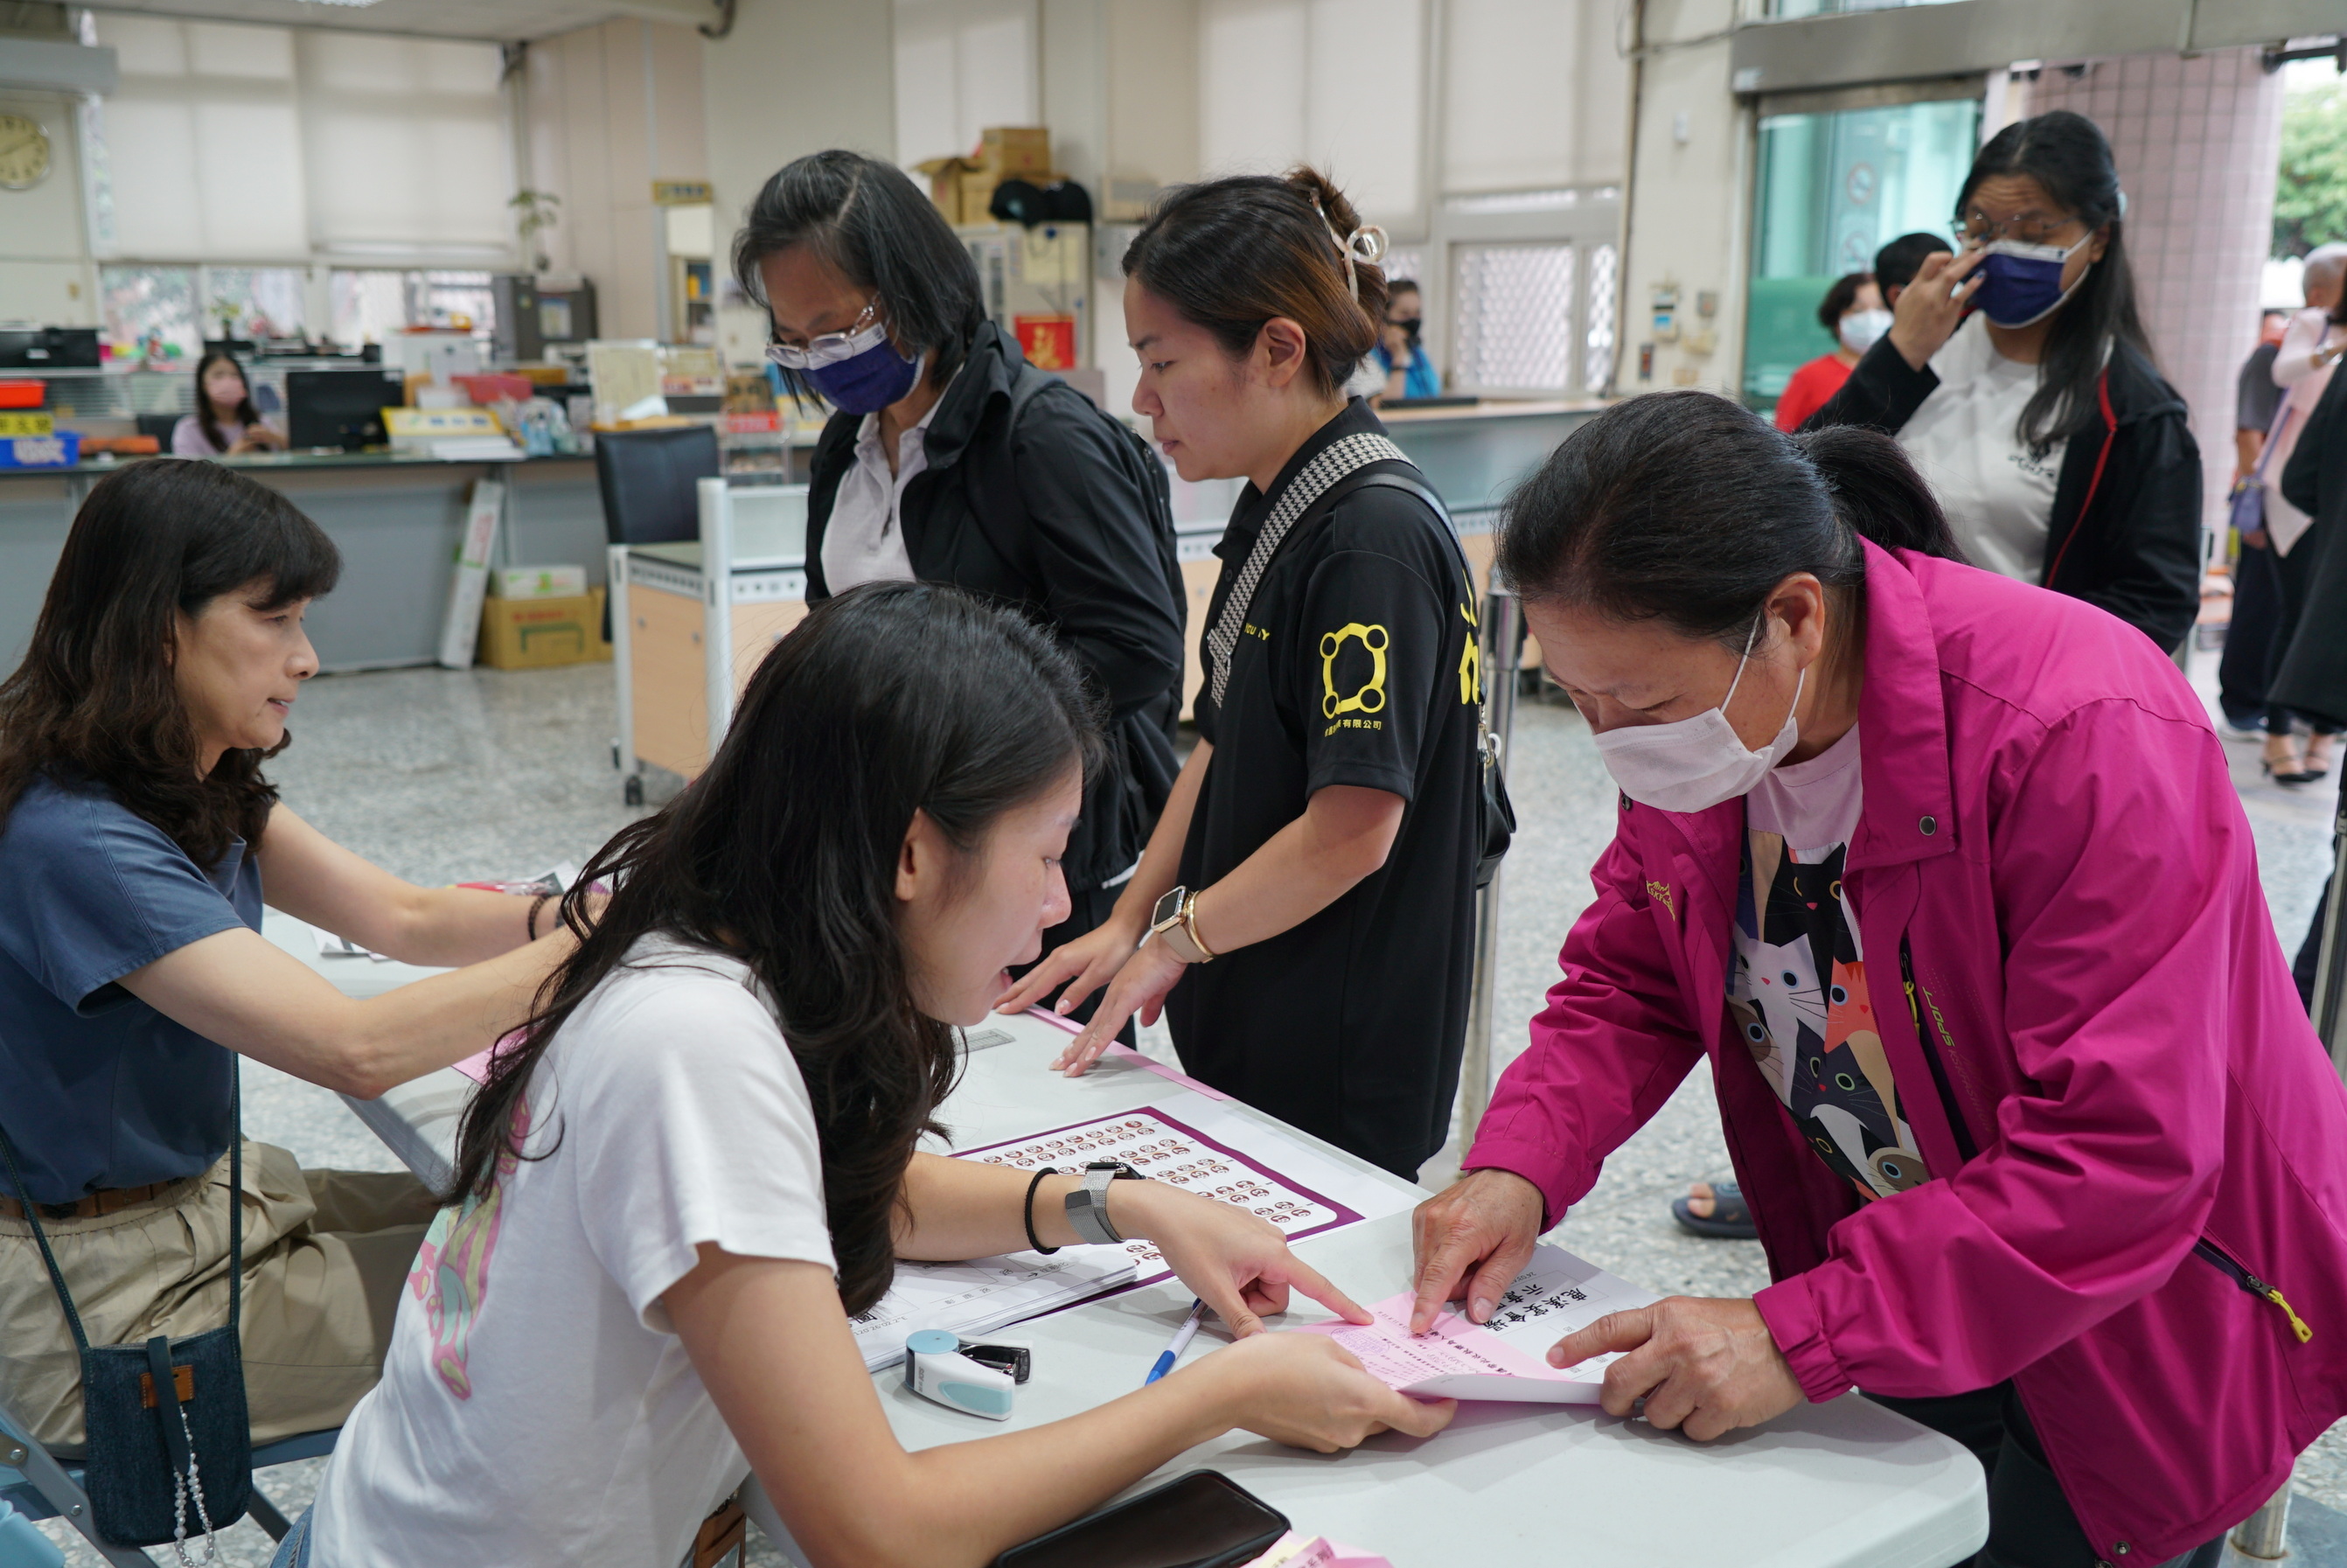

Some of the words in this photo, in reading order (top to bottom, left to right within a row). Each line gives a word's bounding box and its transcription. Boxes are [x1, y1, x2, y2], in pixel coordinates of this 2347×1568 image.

[1922, 986, 1955, 1047] SPORT
[1483, 1287, 1587, 1332] 鹿溪宴會場
